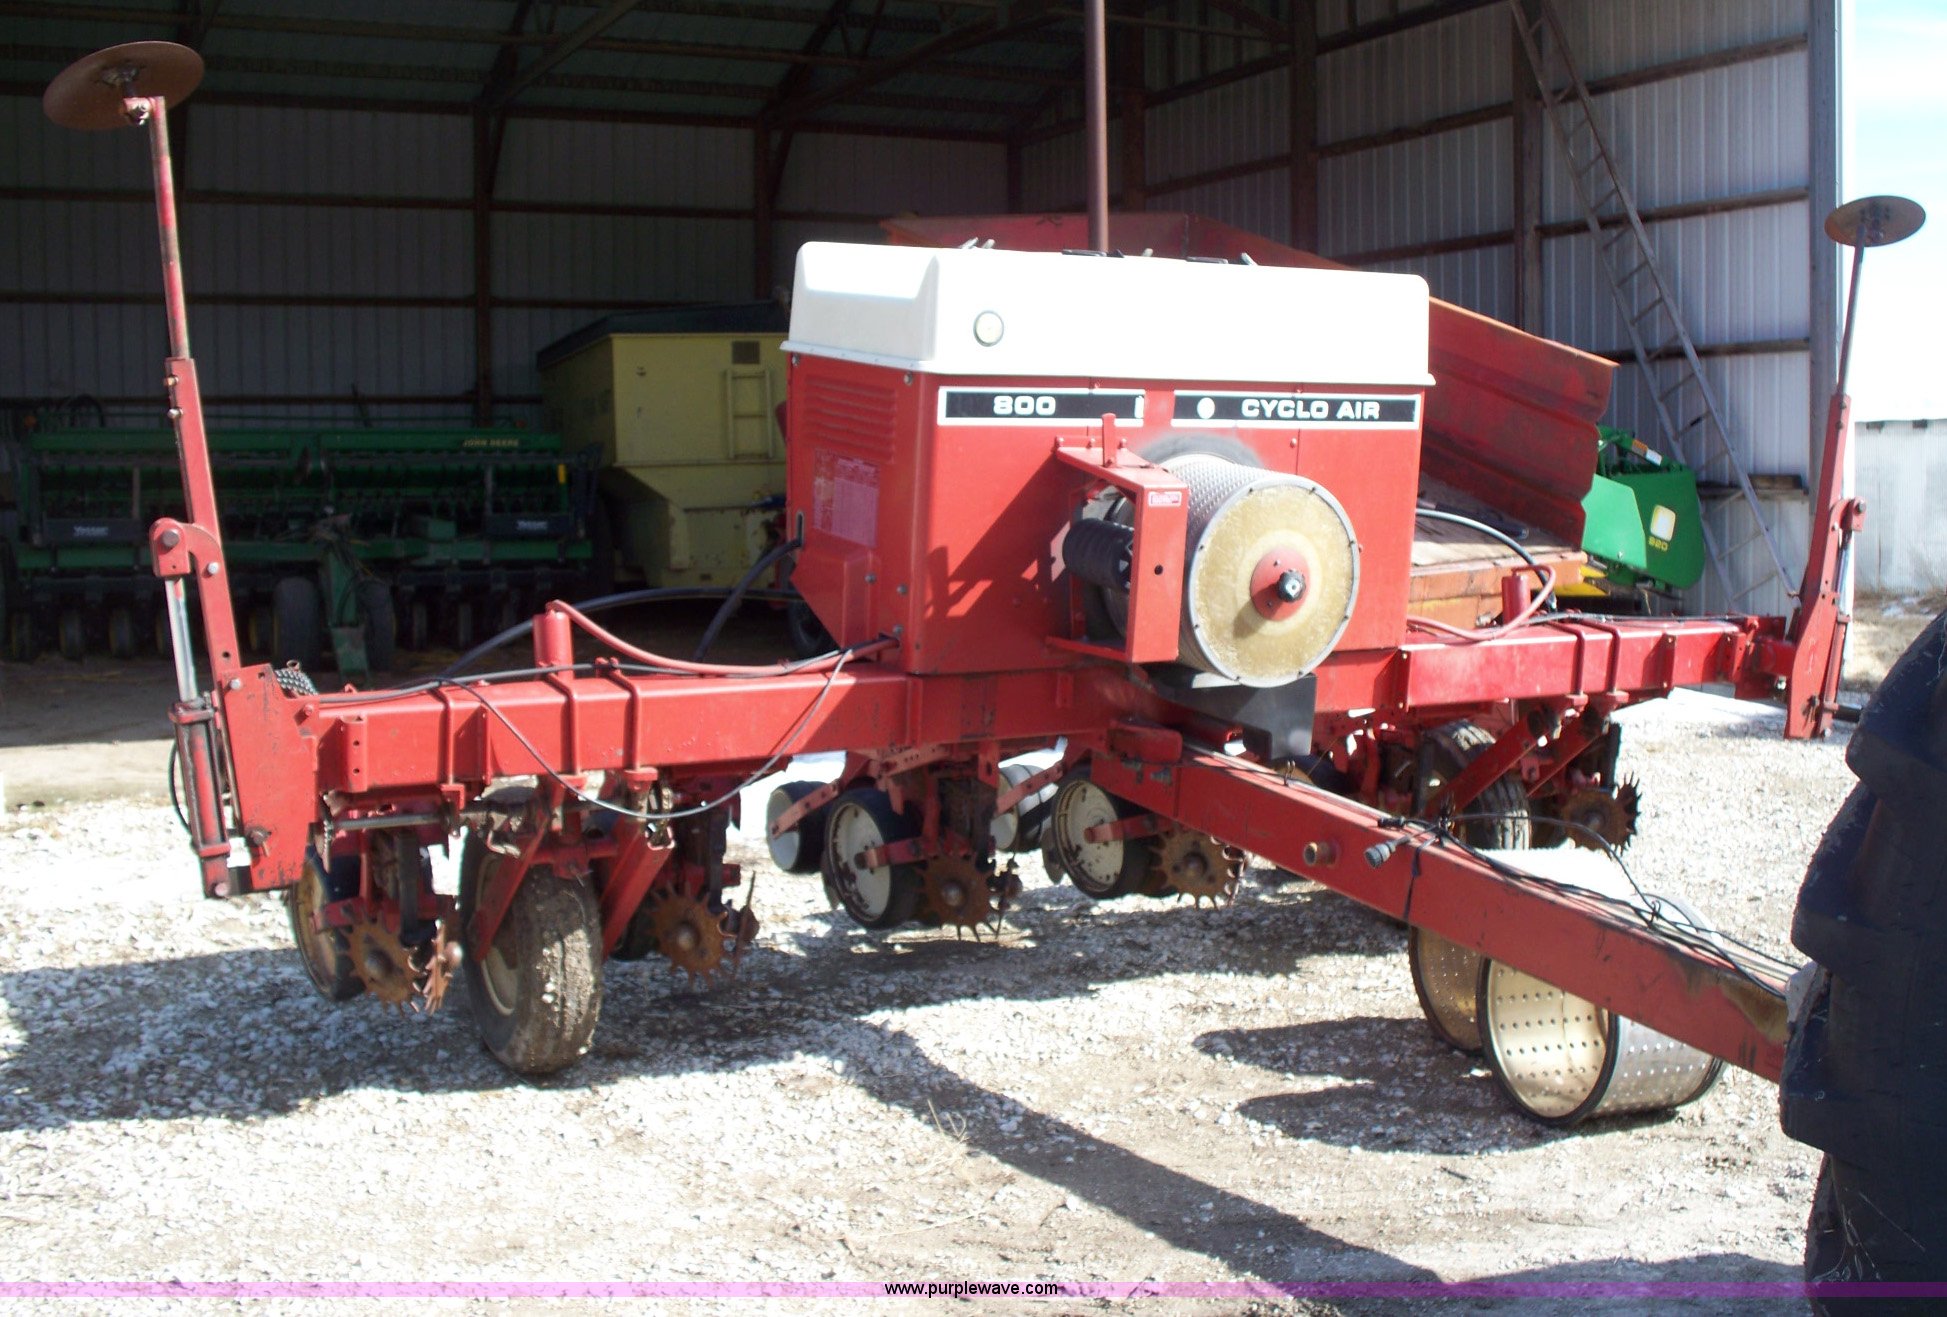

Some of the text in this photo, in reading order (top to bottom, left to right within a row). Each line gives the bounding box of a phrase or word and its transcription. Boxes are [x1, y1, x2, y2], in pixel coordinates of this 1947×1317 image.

[993, 395, 1056, 415] 800
[1241, 398, 1380, 420] CYCLO AIR
